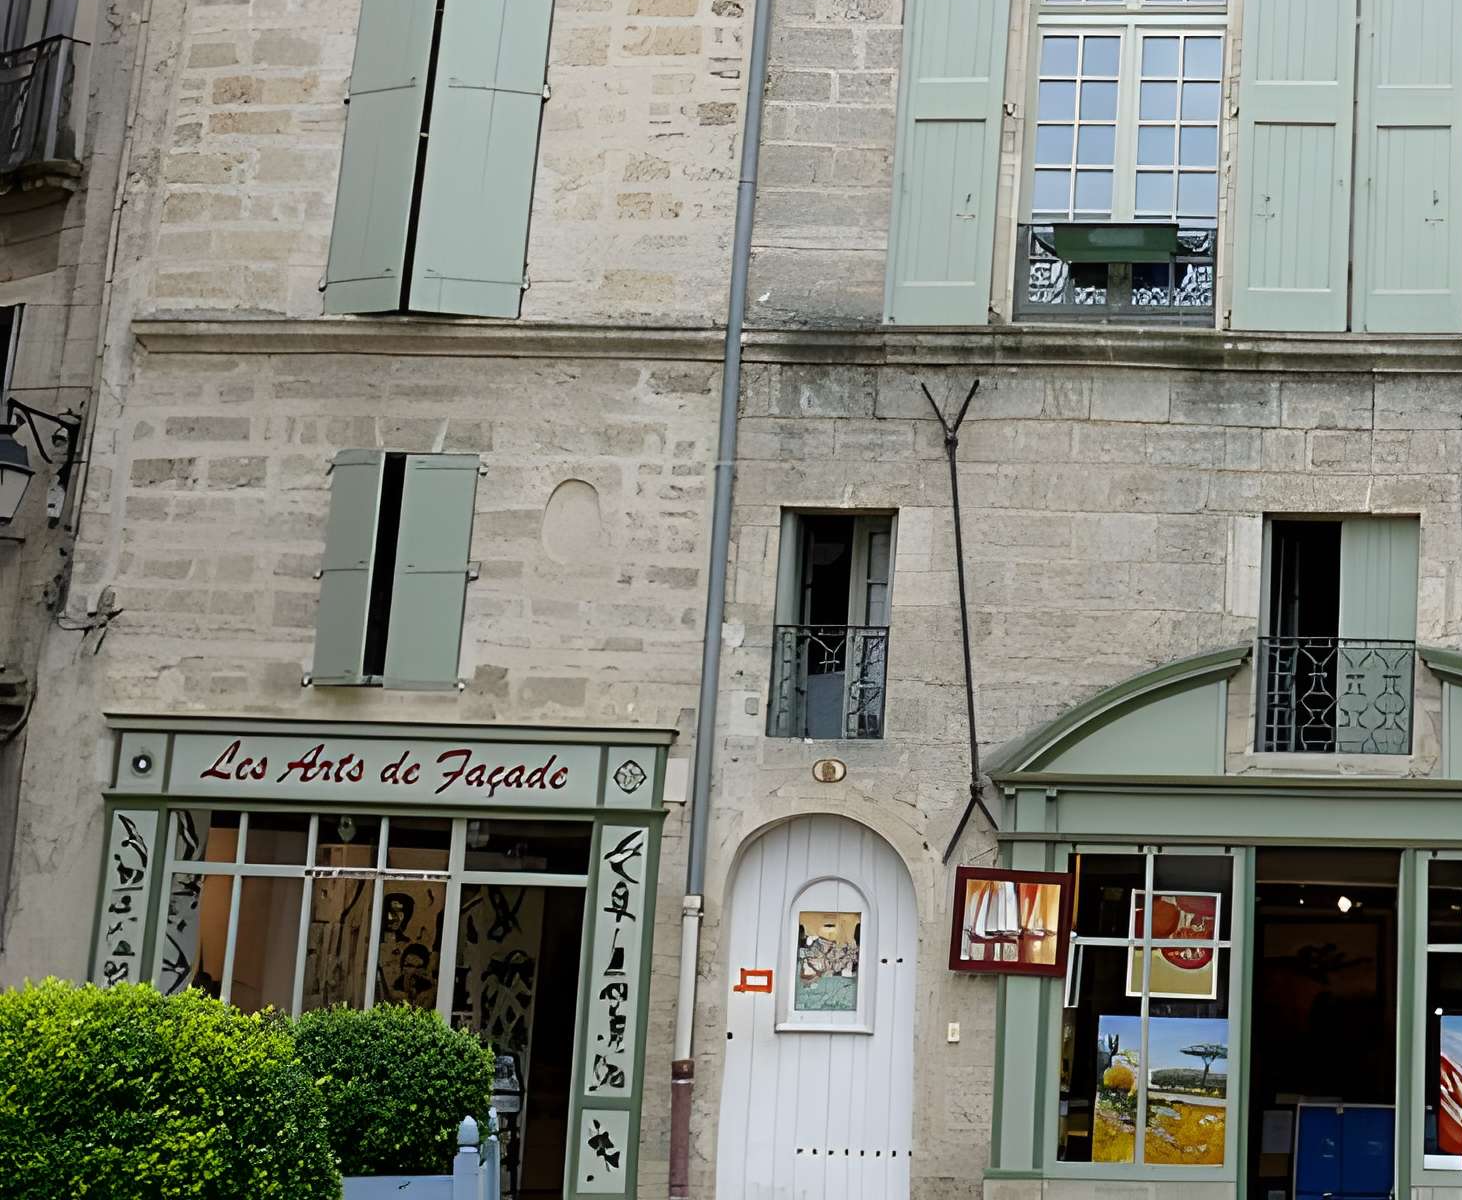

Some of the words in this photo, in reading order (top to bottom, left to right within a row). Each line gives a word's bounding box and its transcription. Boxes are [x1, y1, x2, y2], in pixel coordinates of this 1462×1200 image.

[200, 739, 268, 781] Les
[276, 743, 364, 783] Arts
[380, 750, 420, 785] de
[435, 748, 569, 798] Façade
